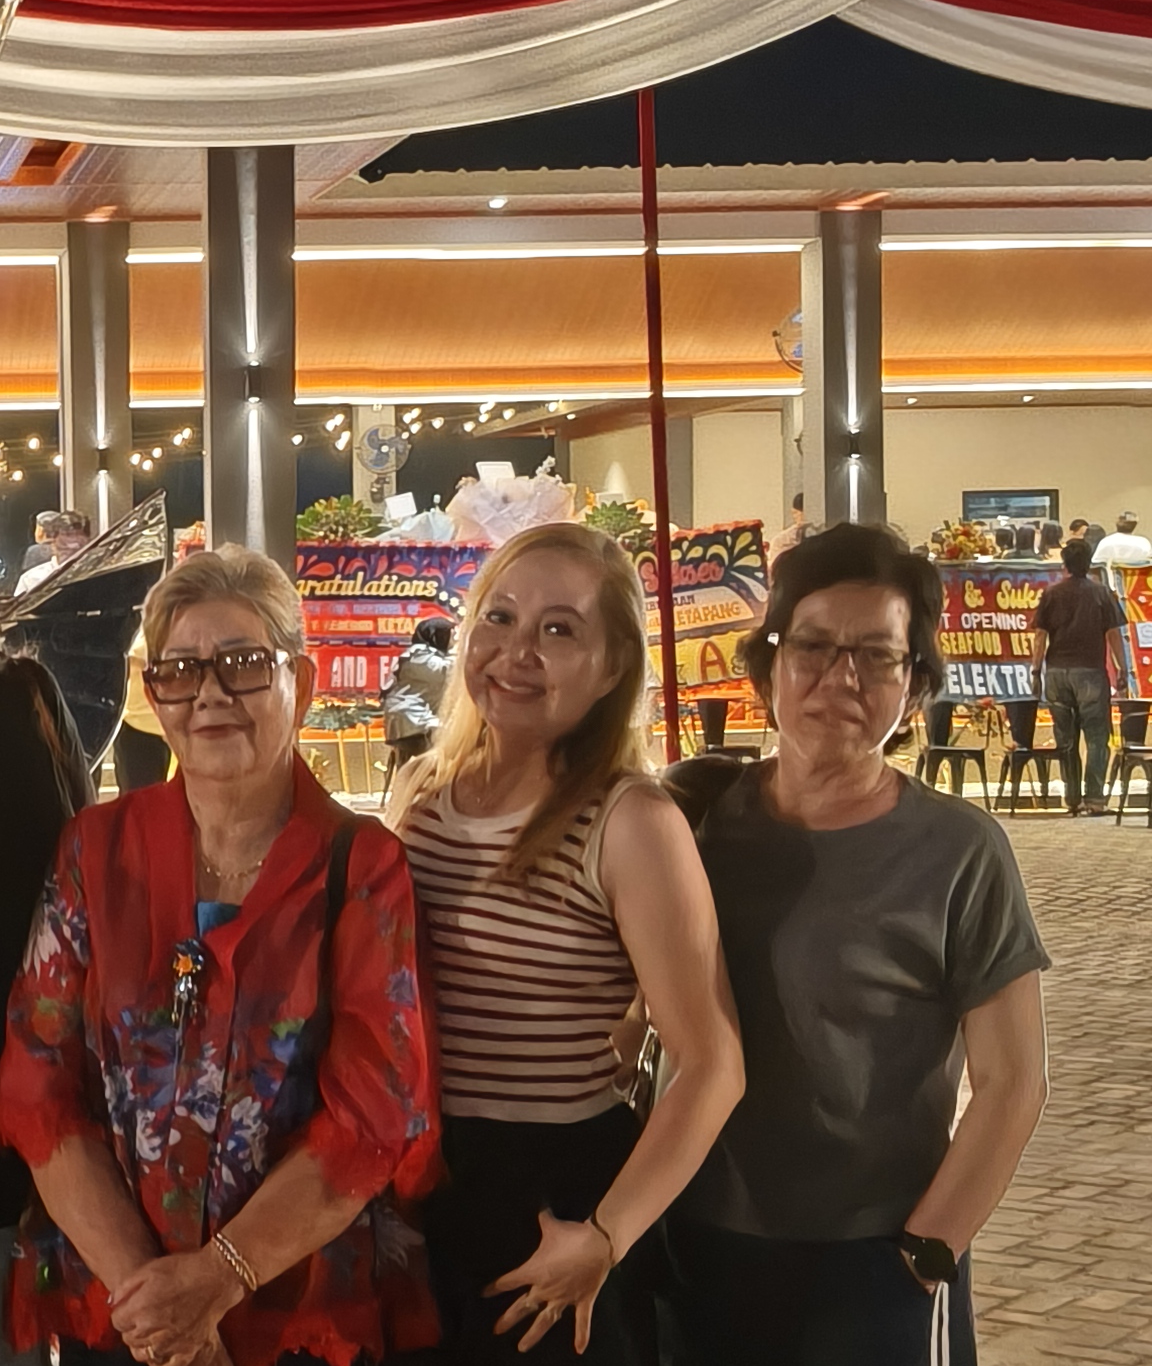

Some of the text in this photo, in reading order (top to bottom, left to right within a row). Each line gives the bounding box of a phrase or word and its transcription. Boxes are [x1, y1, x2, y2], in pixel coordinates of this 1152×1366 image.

[964, 580, 985, 608] &
[961, 612, 1027, 630] OPENING
[940, 631, 1002, 655] SEAFOOD
[331, 656, 367, 688] AND
